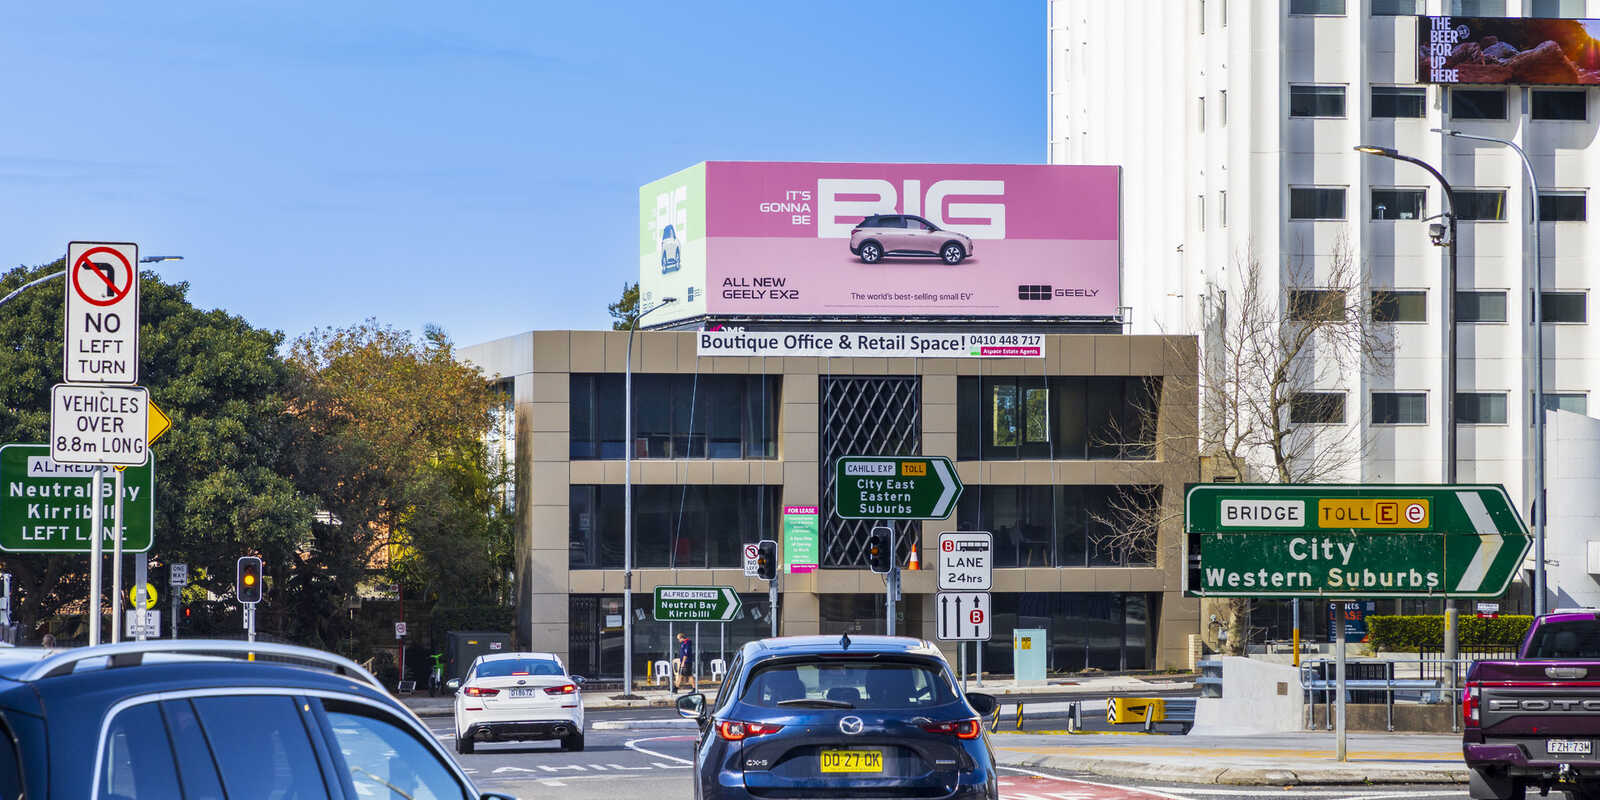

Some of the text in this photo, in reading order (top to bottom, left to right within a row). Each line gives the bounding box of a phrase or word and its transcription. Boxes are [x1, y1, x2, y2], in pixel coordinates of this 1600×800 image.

[1430, 17, 1451, 30] THE
[1430, 30, 1459, 43] BEER
[1430, 43, 1452, 56] FOR
[1430, 56, 1447, 69] UP
[1430, 69, 1459, 82] HERE
[786, 191, 811, 200] IT'S
[760, 203, 811, 212] GONNA
[817, 178, 1005, 239] BIG
[792, 215, 811, 224] BE
[722, 277, 786, 287] ALL NEW
[722, 290, 799, 299] GEELY EX2
[851, 292, 865, 300] The
[867, 292, 892, 300] world's
[895, 292, 938, 302] best-selling
[940, 292, 958, 300] small
[1055, 288, 1099, 297] GEELY
[85, 313, 121, 333] NO
[79, 340, 124, 353] LEFT
[701, 334, 1041, 353] Boutique Office & Retail Space! 0410 448 717
[79, 360, 125, 374] TURN
[63, 396, 139, 413] VEHICLES
[77, 416, 124, 433] OVER
[57, 436, 143, 453] 8.8m LONG
[33, 461, 94, 473] ALFRED
[848, 465, 924, 473] CAHILL EXP TOLL
[857, 479, 915, 490] City East
[10, 482, 140, 501] Neutral By
[860, 492, 911, 501] Eastern
[28, 503, 116, 519] Kirribll
[860, 504, 912, 513] Suburbs
[1227, 506, 1299, 521] BRIDGE
[1322, 506, 1370, 521] TOLL
[1381, 506, 1392, 521] E
[22, 526, 69, 541] LEFT
[1289, 538, 1355, 564] City
[947, 558, 983, 567] LANE
[948, 573, 983, 583] 24hrs
[1205, 568, 1440, 588] Western Suburbs
[700, 602, 717, 610] Bay
